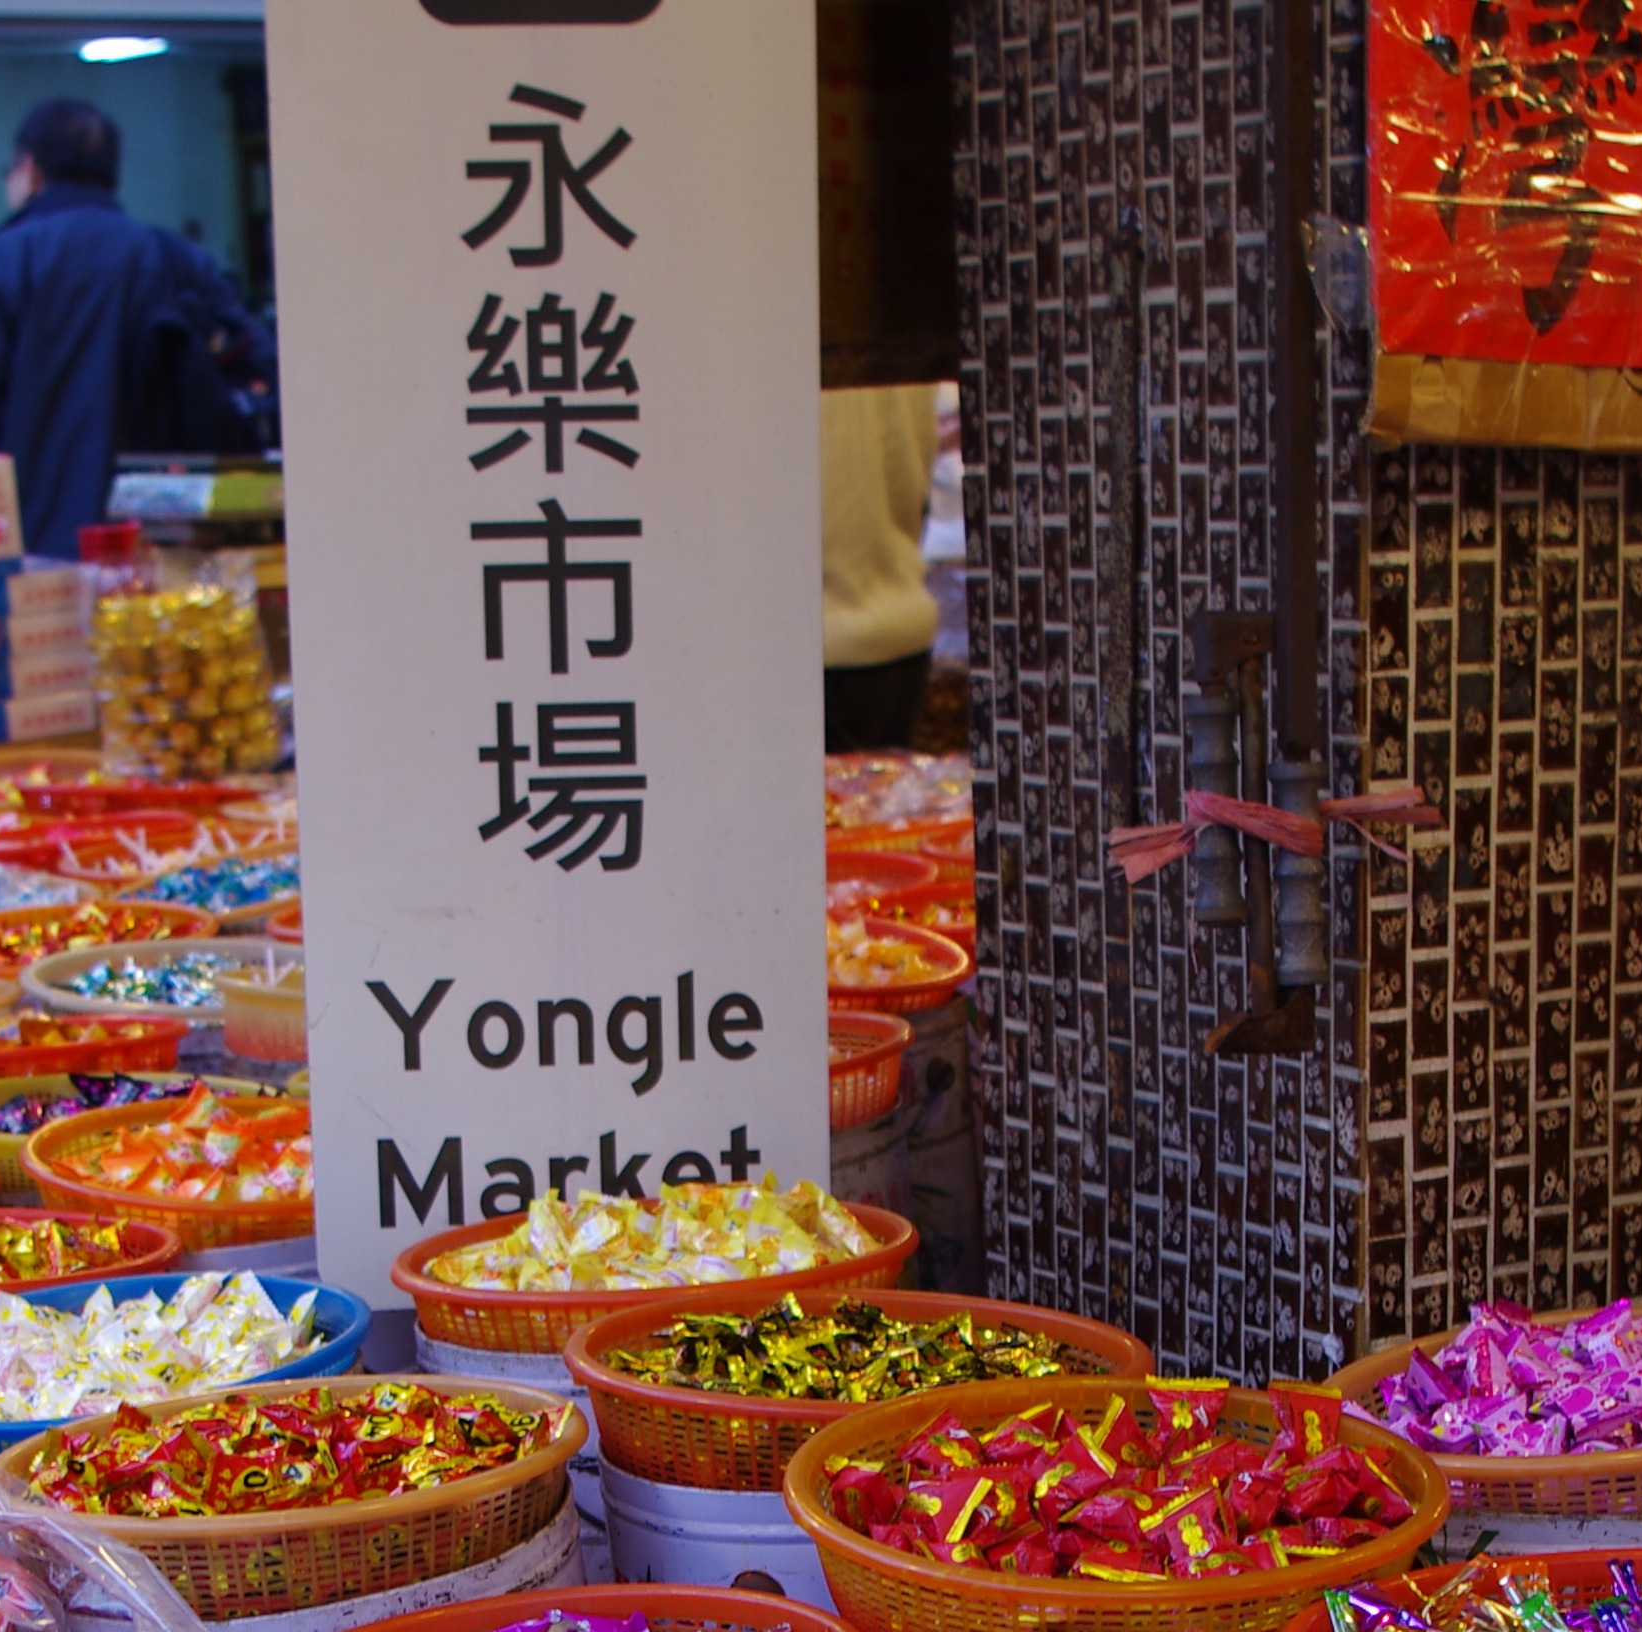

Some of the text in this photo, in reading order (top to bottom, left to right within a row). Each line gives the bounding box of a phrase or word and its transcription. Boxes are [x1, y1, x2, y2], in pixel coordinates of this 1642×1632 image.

[460, 83, 648, 873] 永樂市場
[365, 970, 764, 1096] Yongle
[378, 1124, 762, 1229] Market
